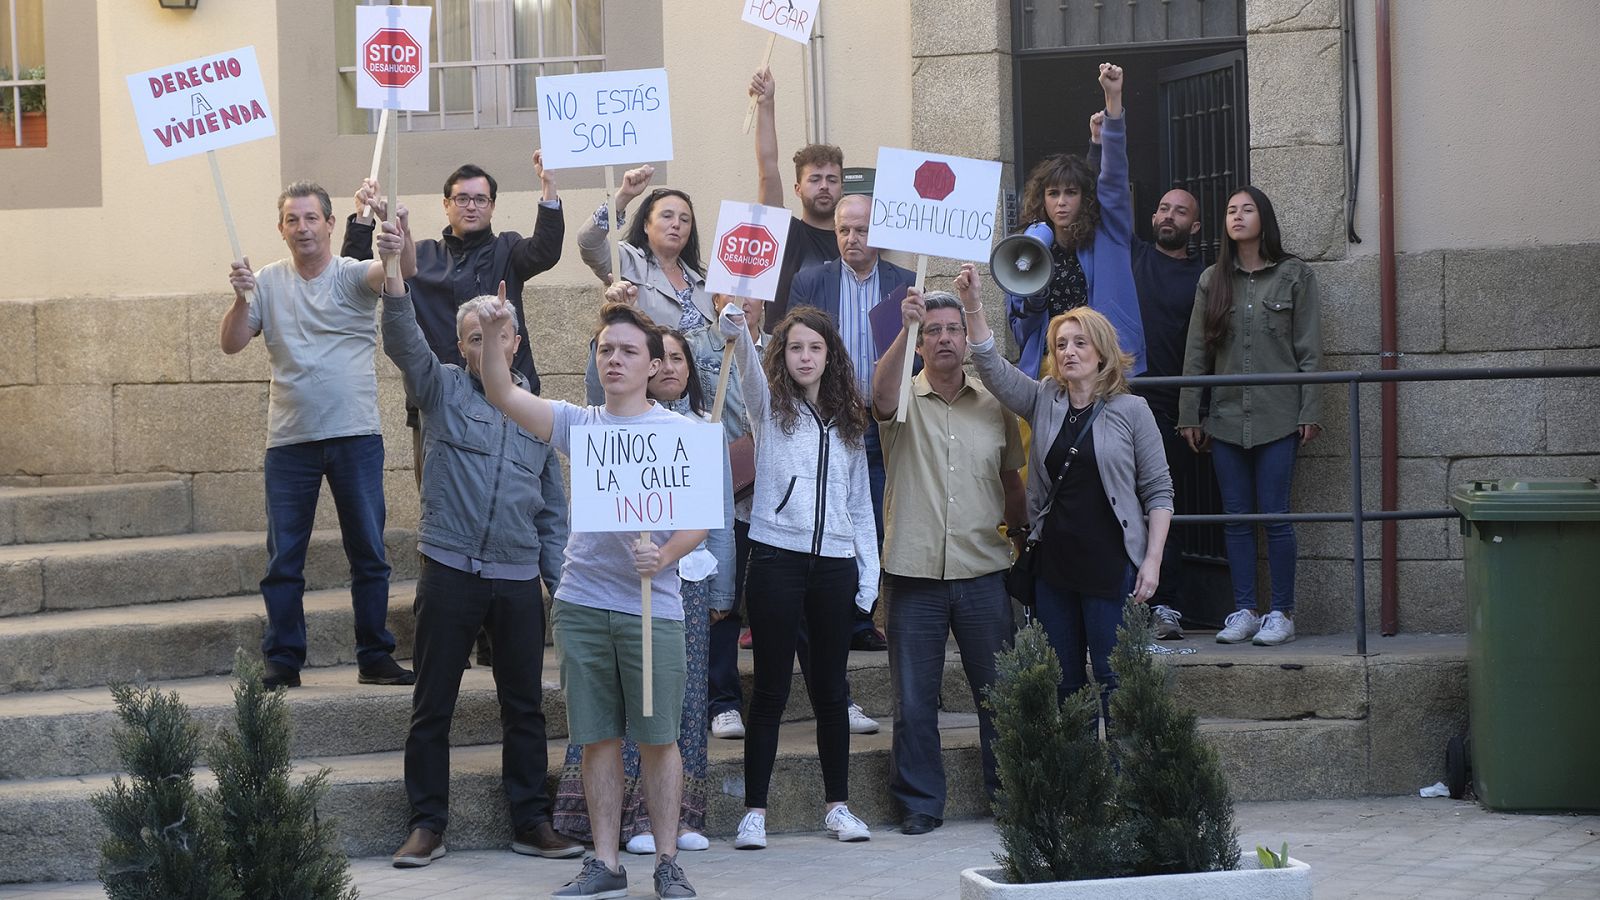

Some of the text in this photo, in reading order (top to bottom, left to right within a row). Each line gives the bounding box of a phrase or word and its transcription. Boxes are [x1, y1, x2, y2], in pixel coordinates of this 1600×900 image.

[750, 0, 809, 34] HOGAR
[369, 43, 417, 63] STOP
[148, 57, 242, 99] DERECHO
[369, 63, 417, 73] DESAHUCIOS
[190, 92, 213, 117] A
[546, 83, 661, 120] NO ESTÁS
[570, 120, 638, 153] SOLA
[872, 198, 994, 241] DESAHUCIOS
[723, 252, 770, 267] DESAHUCIOS
[725, 235, 773, 257] STOP
[673, 436, 689, 463] A
[596, 465, 692, 492] LA CALLE
[615, 490, 675, 526] ¡NO!
